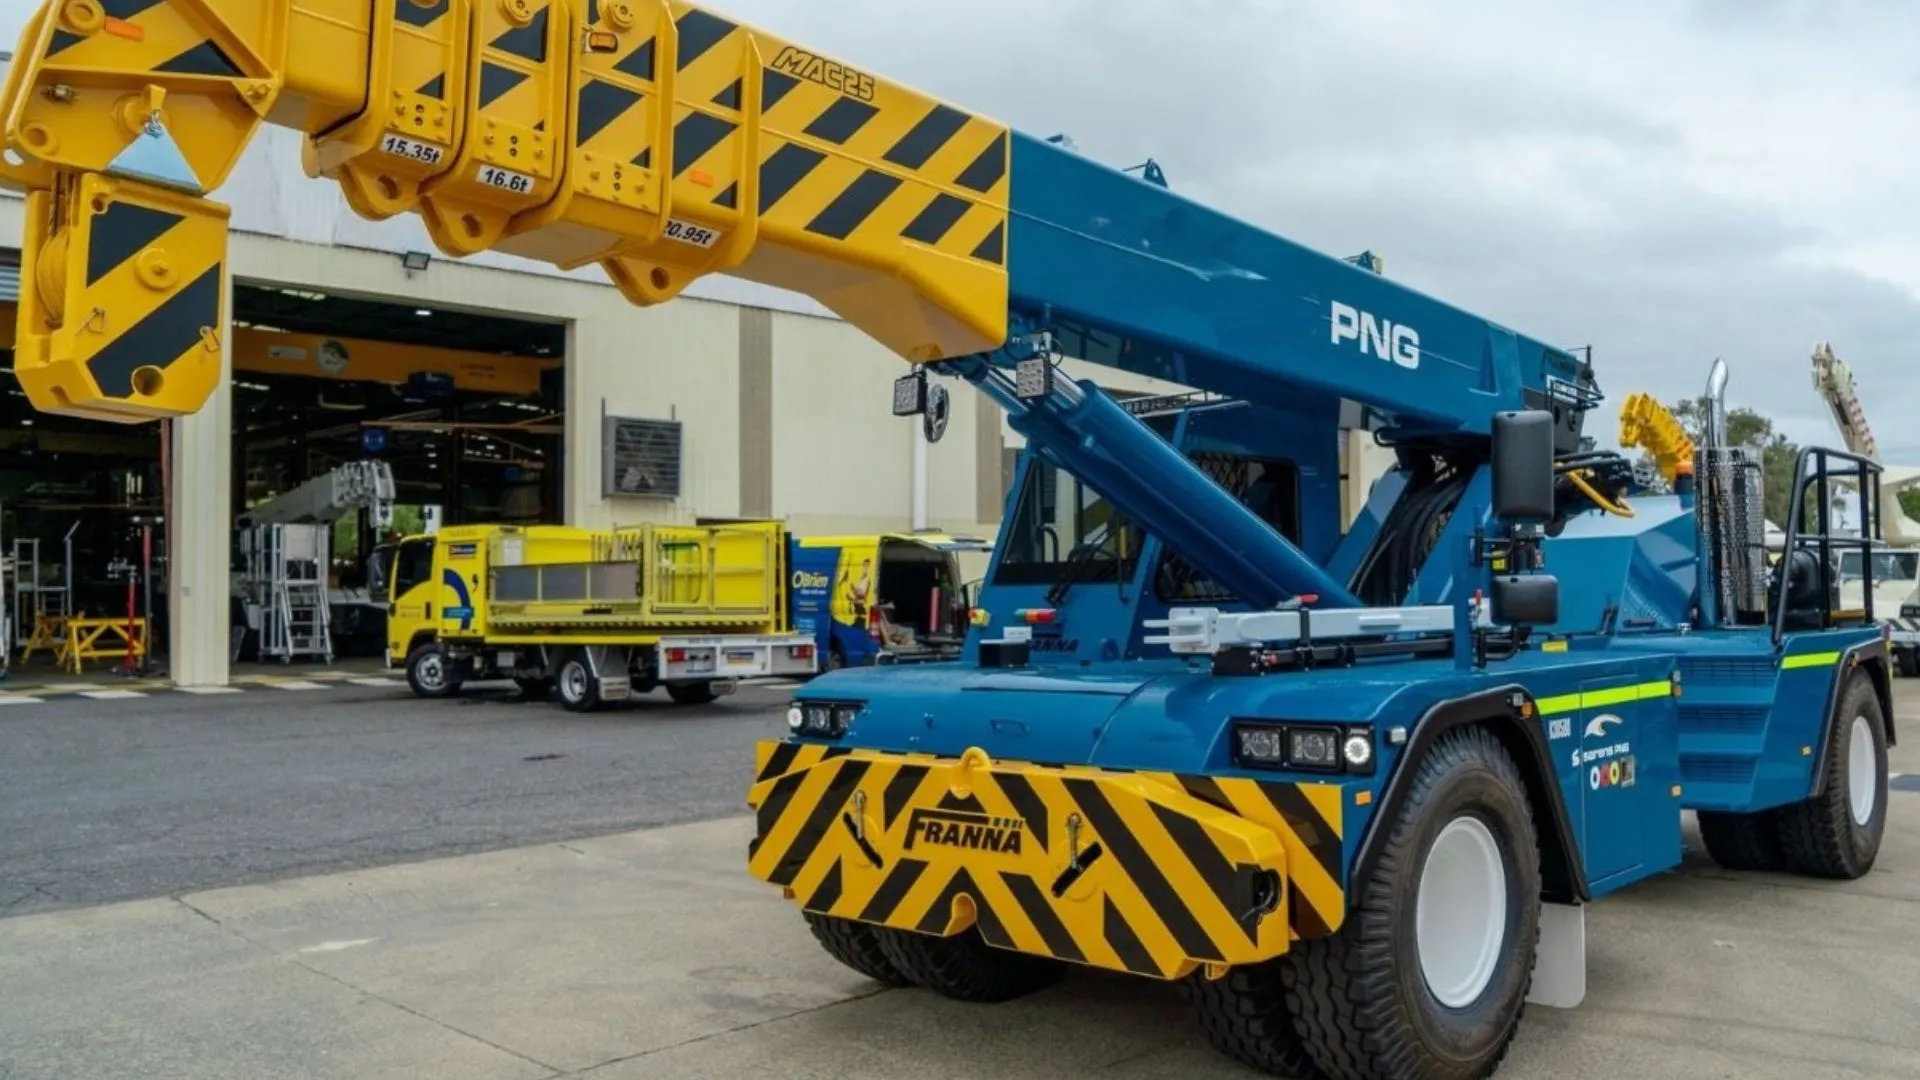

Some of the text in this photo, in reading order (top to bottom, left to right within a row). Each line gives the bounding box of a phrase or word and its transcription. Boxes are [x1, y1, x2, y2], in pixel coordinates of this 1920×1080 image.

[771, 46, 875, 101] MAC25
[386, 137, 440, 163] 15.35t
[485, 168, 528, 192] 16.6t
[1331, 300, 1420, 370] PNG
[903, 808, 1022, 855] FRANNA
